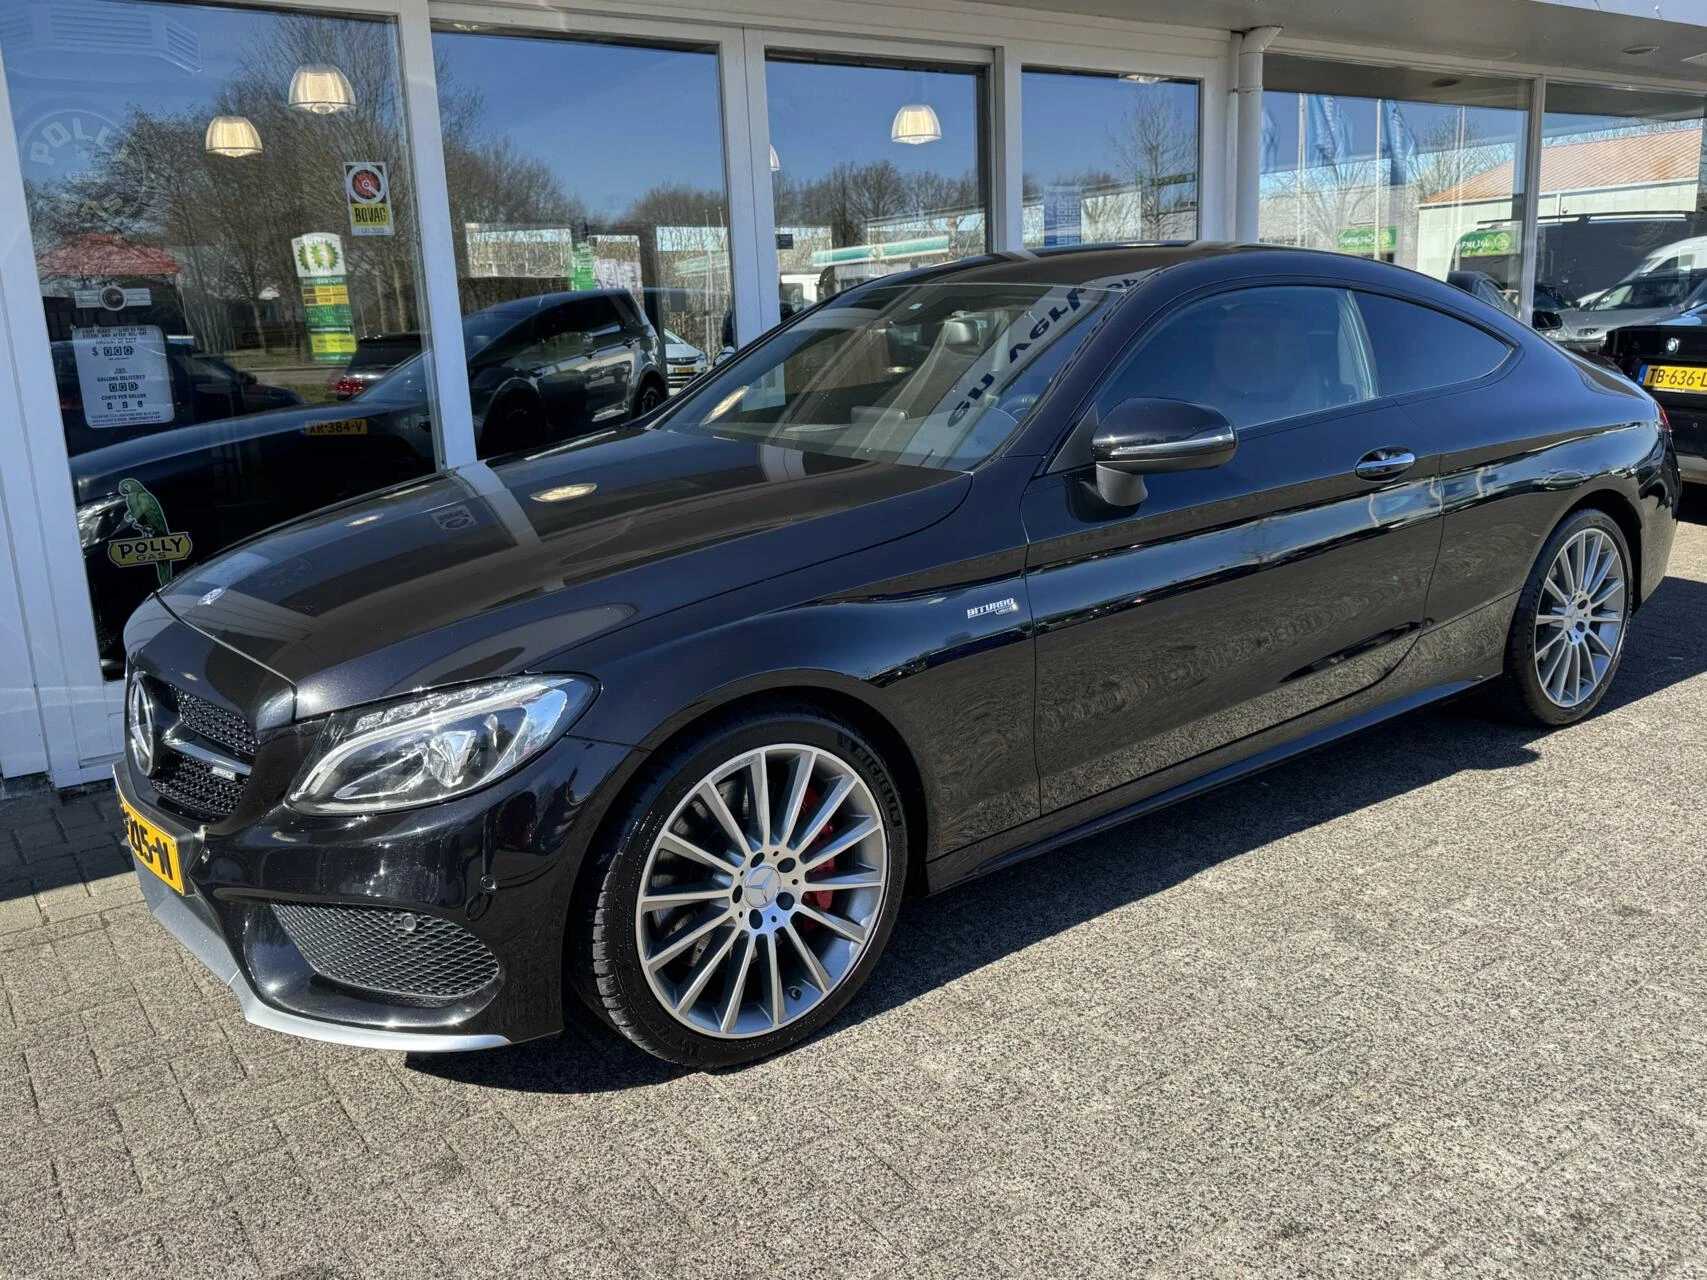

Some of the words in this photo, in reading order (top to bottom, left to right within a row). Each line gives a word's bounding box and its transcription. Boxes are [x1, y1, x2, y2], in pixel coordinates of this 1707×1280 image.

[354, 207, 387, 223] BOVAG
[1649, 368, 1707, 388] TB-636-L
[118, 537, 183, 560] POLLY
[136, 552, 167, 561] GAS
[967, 597, 1014, 617] BITURBO
